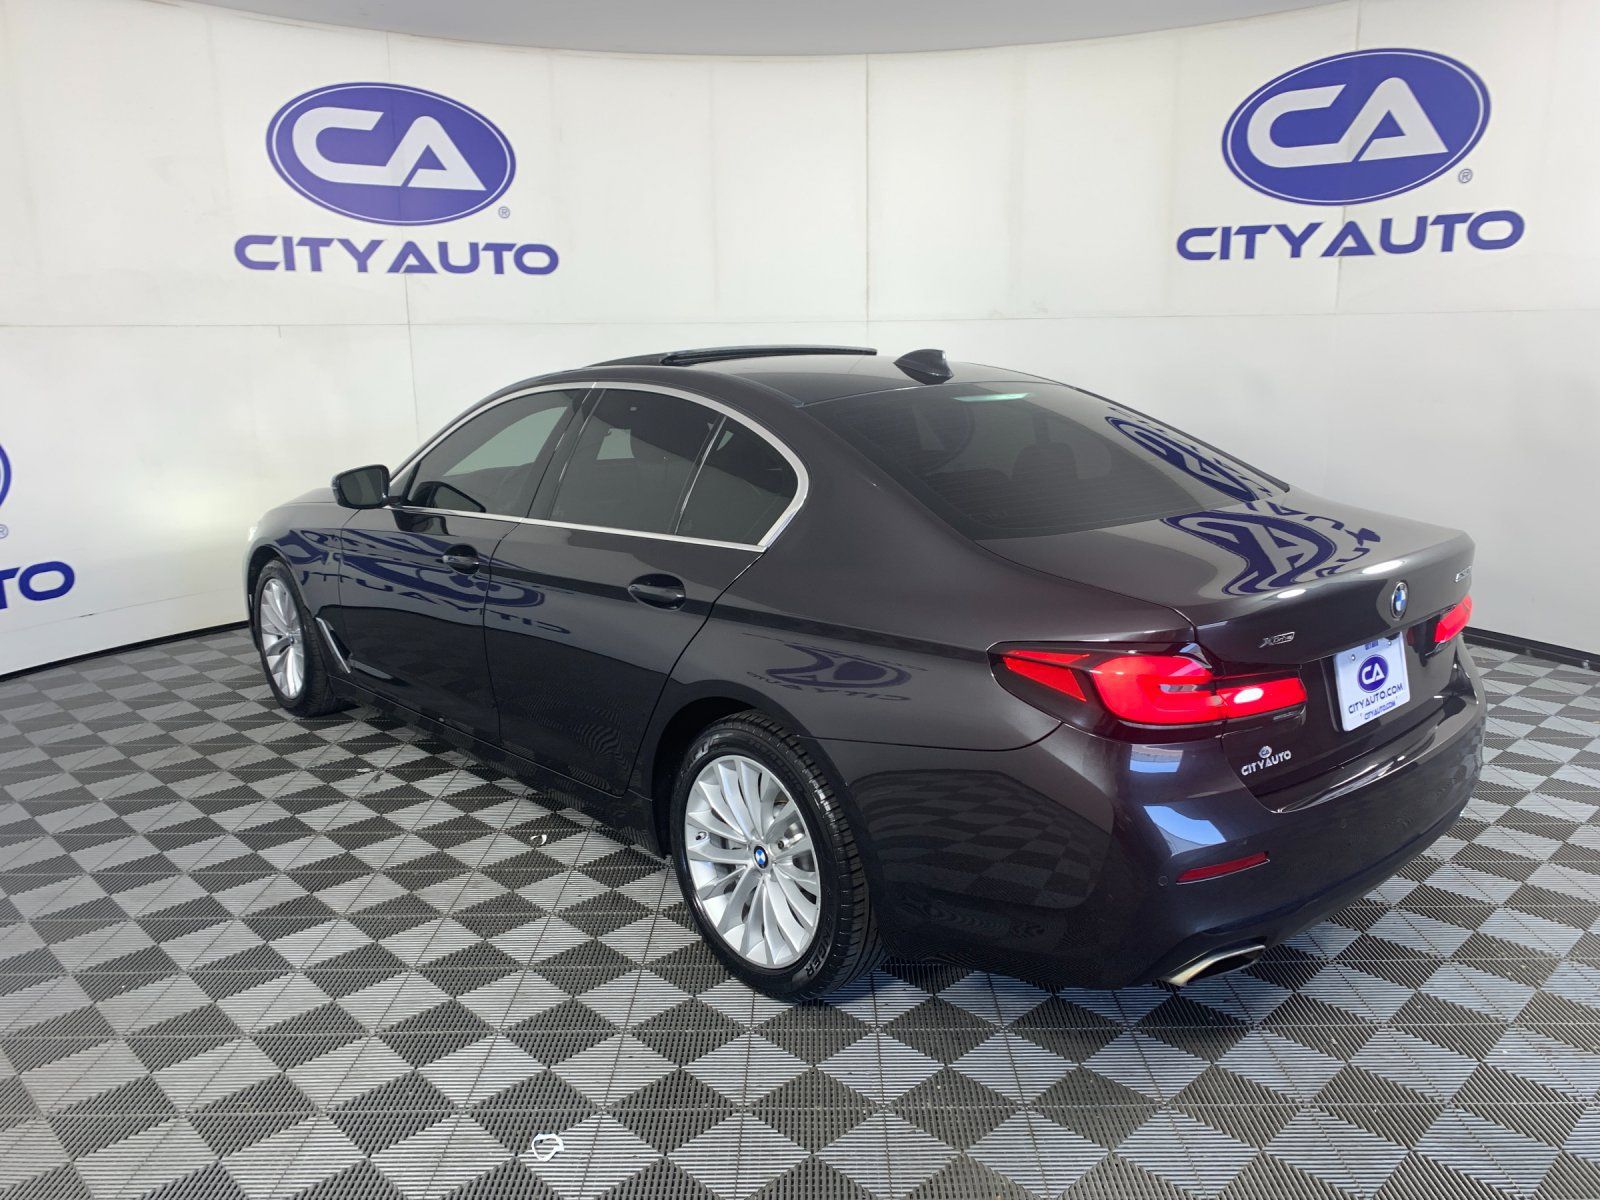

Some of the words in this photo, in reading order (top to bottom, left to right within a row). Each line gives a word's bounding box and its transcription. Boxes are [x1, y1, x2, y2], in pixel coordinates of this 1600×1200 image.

[292, 106, 487, 191] CA
[1247, 76, 1449, 169] CA
[1348, 682, 1404, 714] CITYAUTO.COM
[1361, 662, 1386, 685] CA
